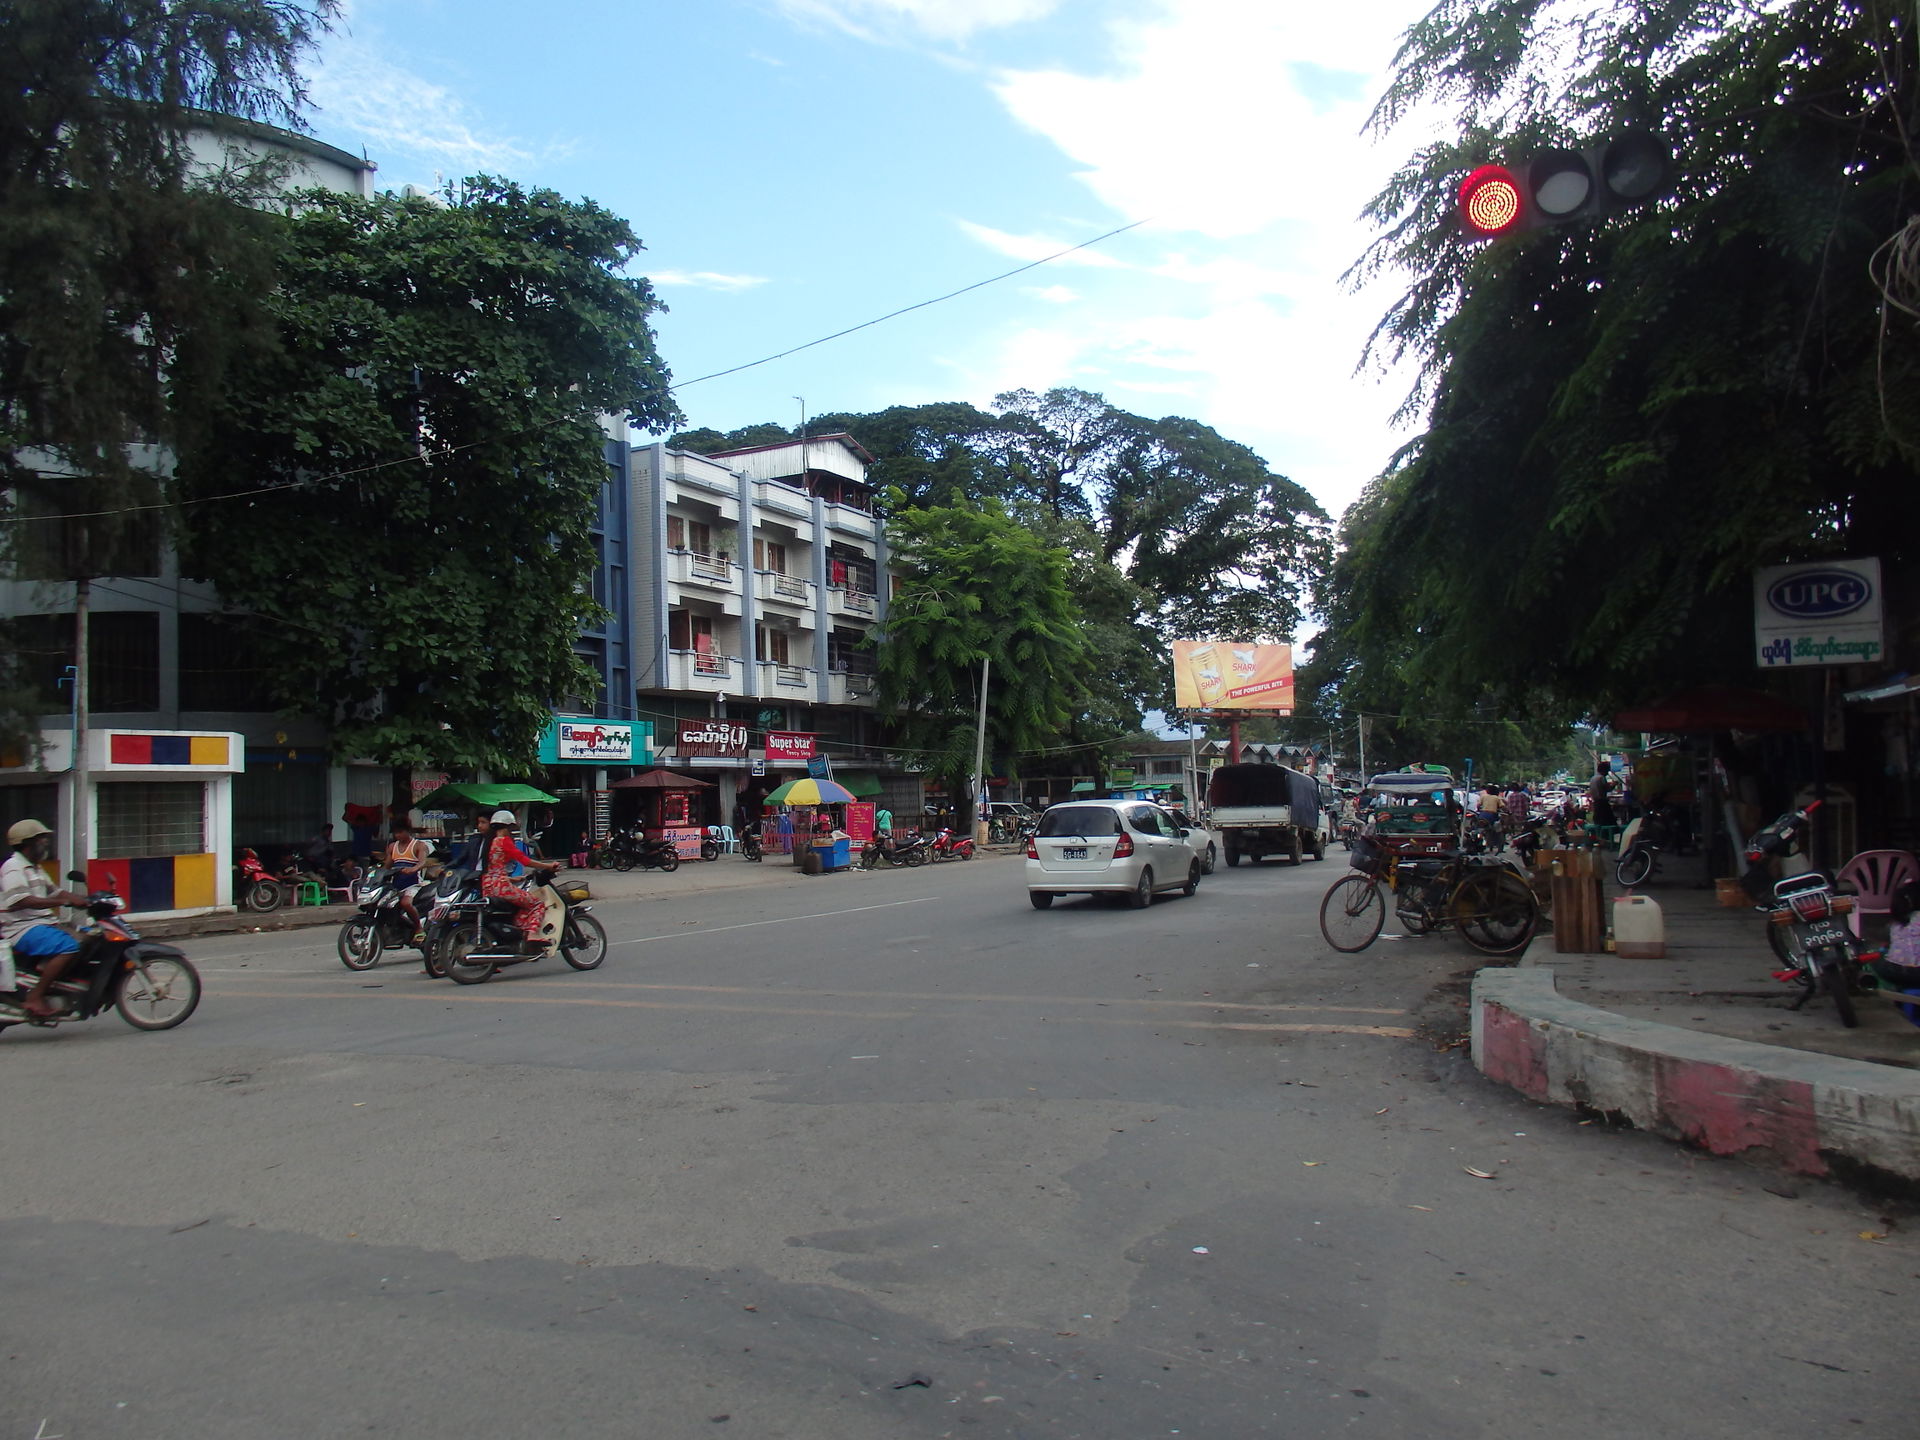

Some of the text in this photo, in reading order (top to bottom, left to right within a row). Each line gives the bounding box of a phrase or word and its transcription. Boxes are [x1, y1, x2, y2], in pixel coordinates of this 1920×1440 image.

[1783, 581, 1858, 606] UPG
[1232, 663, 1256, 672] SHARK
[1231, 680, 1283, 697] THE POWERFUL BITE
[769, 735, 793, 751] Super
